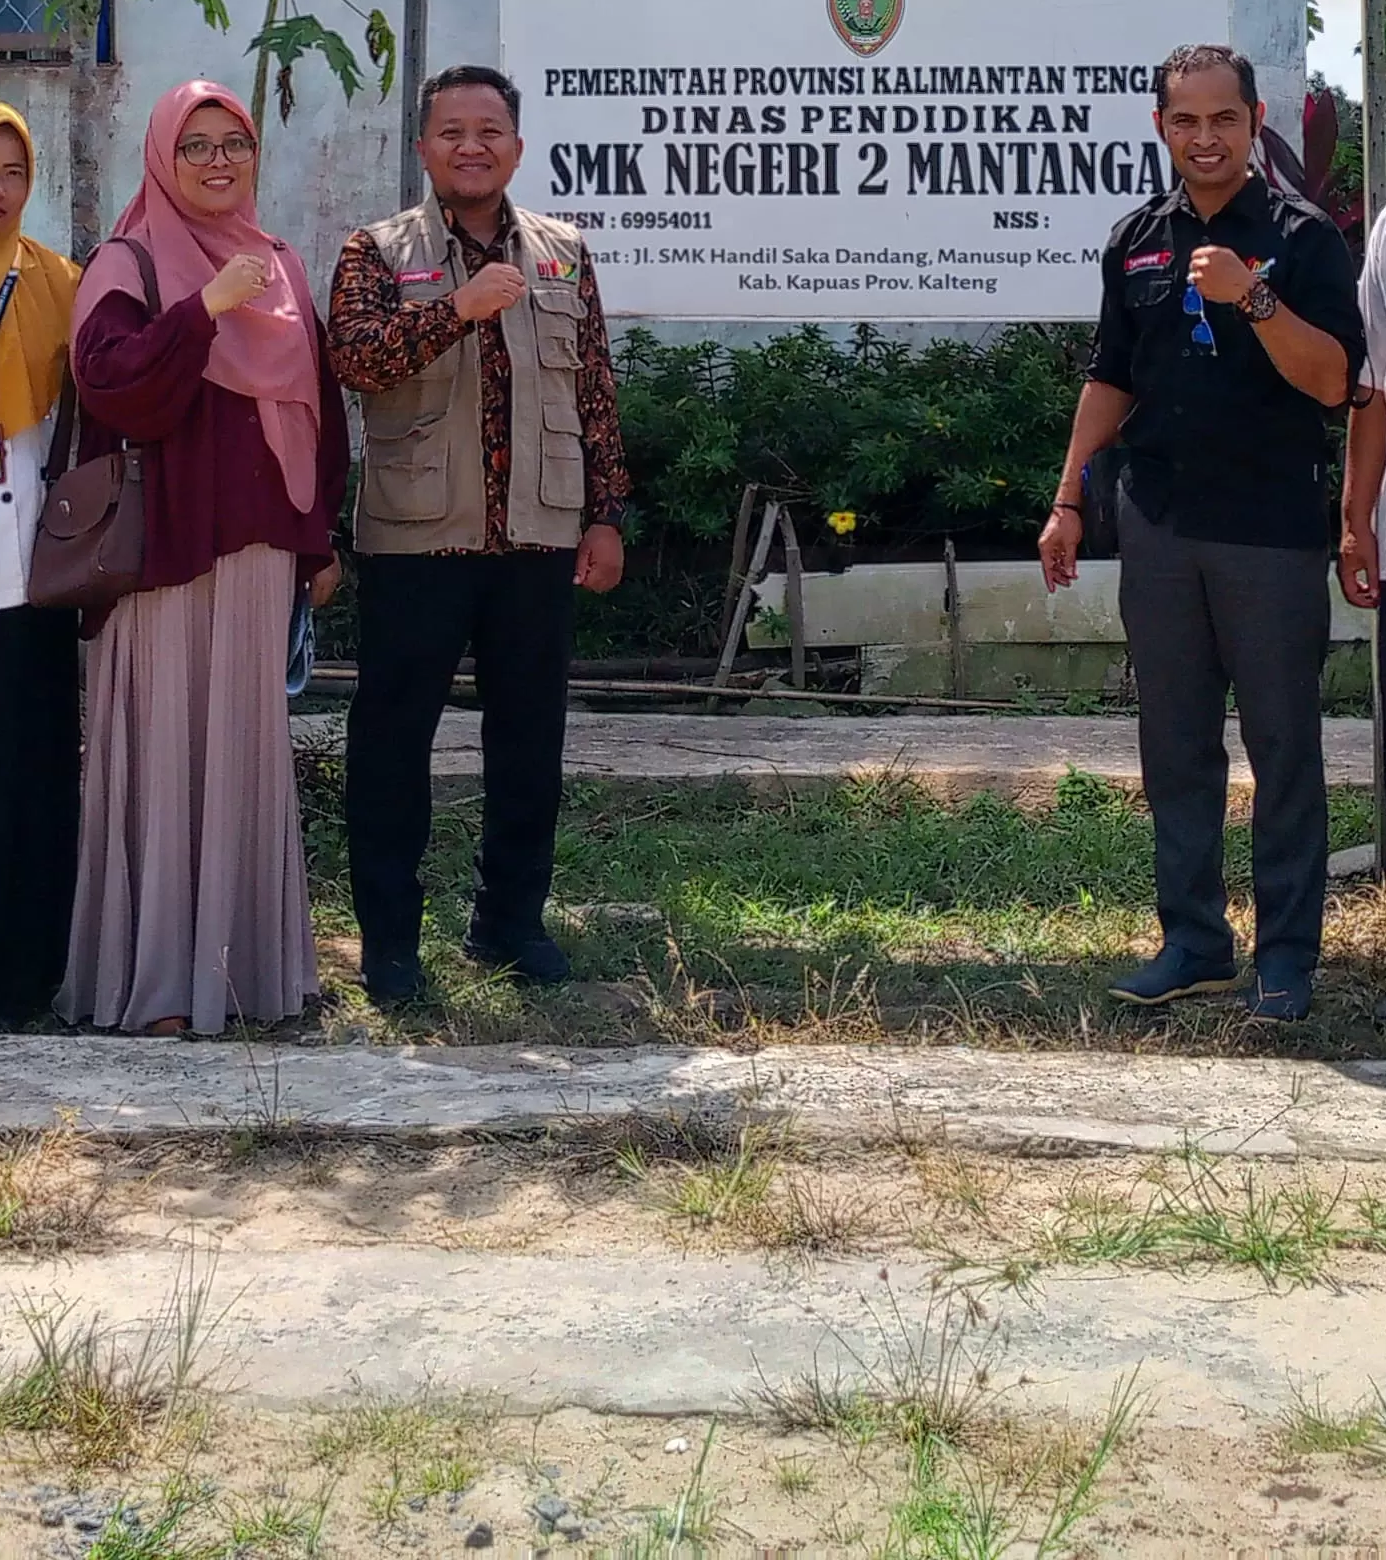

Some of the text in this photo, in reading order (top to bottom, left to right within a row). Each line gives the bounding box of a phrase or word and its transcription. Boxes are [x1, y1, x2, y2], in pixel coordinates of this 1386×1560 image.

[544, 65, 1159, 97] PEMERINTAH PROVINSI KALIMANTAN TENGA
[641, 104, 1092, 135] DINAS PENDIDIKAN
[549, 142, 648, 197] SMK
[663, 141, 841, 196] NEGERI
[857, 142, 889, 196] 2
[620, 211, 713, 230] 69954011
[992, 210, 1039, 230] NSS
[633, 247, 654, 266] Jl.
[658, 247, 706, 264] SMK
[710, 247, 777, 264] Handil
[782, 247, 830, 264] Saka
[835, 247, 933, 269] Dandang,
[937, 248, 1032, 268] Manusup
[1036, 248, 1077, 264] Kec.
[738, 273, 998, 294] Kab. Kapuas Prov. Kalteng
